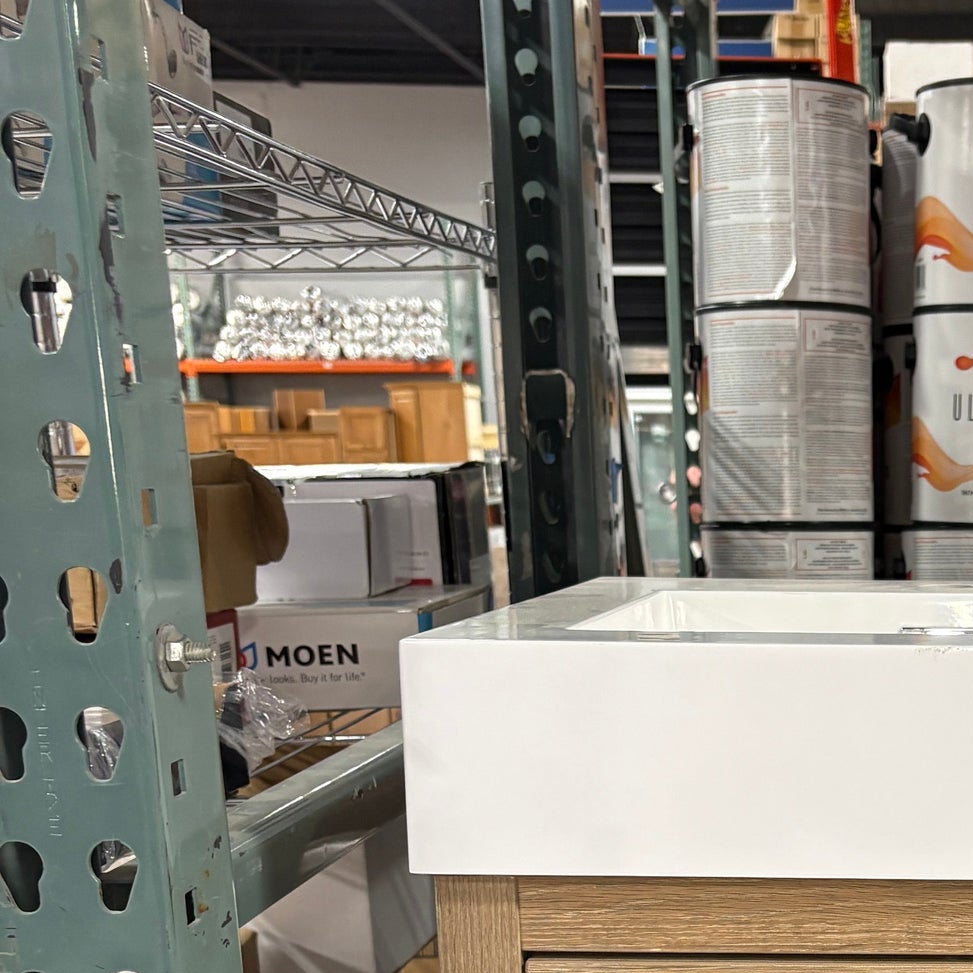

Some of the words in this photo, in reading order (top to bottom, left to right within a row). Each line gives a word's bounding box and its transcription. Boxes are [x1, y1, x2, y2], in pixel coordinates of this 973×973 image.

[265, 643, 360, 668] MOEN
[300, 672, 318, 684] Buy
[320, 672, 327, 682] it
[330, 672, 342, 682] for
